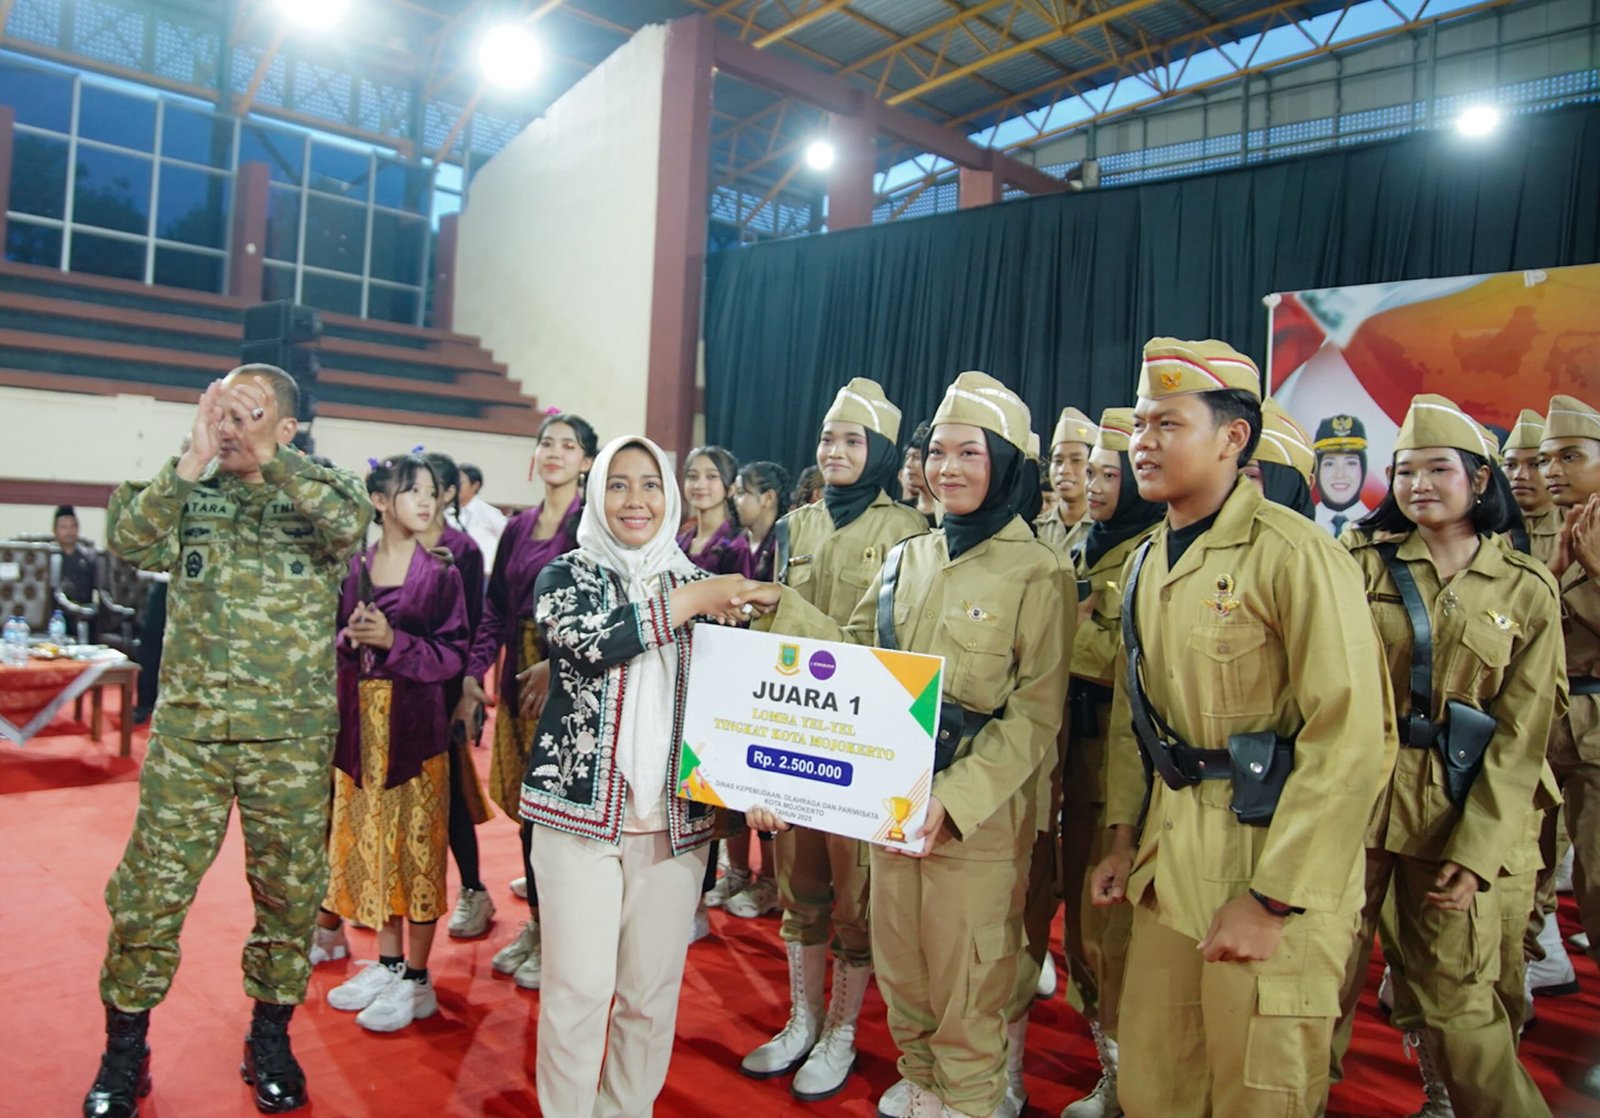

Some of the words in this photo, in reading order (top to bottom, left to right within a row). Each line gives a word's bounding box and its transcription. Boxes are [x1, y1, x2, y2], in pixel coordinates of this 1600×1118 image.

[752, 681, 839, 712] JUARA
[849, 696, 861, 715] 1
[752, 708, 798, 726] LOMBA
[801, 716, 856, 736] YEL-YEL
[714, 717, 769, 738] TINGKAT
[771, 728, 807, 745] KOTA
[809, 734, 895, 761] MOJOKERTO
[753, 750, 775, 768] Rp.
[778, 756, 842, 779] 2.500.000
[715, 780, 735, 790] DINAS
[783, 794, 821, 807] OLAHRAGA
[822, 802, 837, 811] DAN
[838, 806, 879, 819] PARIWISATA
[764, 799, 782, 807] KOTA
[783, 802, 825, 817] MOJOKERTO
[775, 808, 797, 818] TAHUN
[797, 813, 813, 822] 2025
